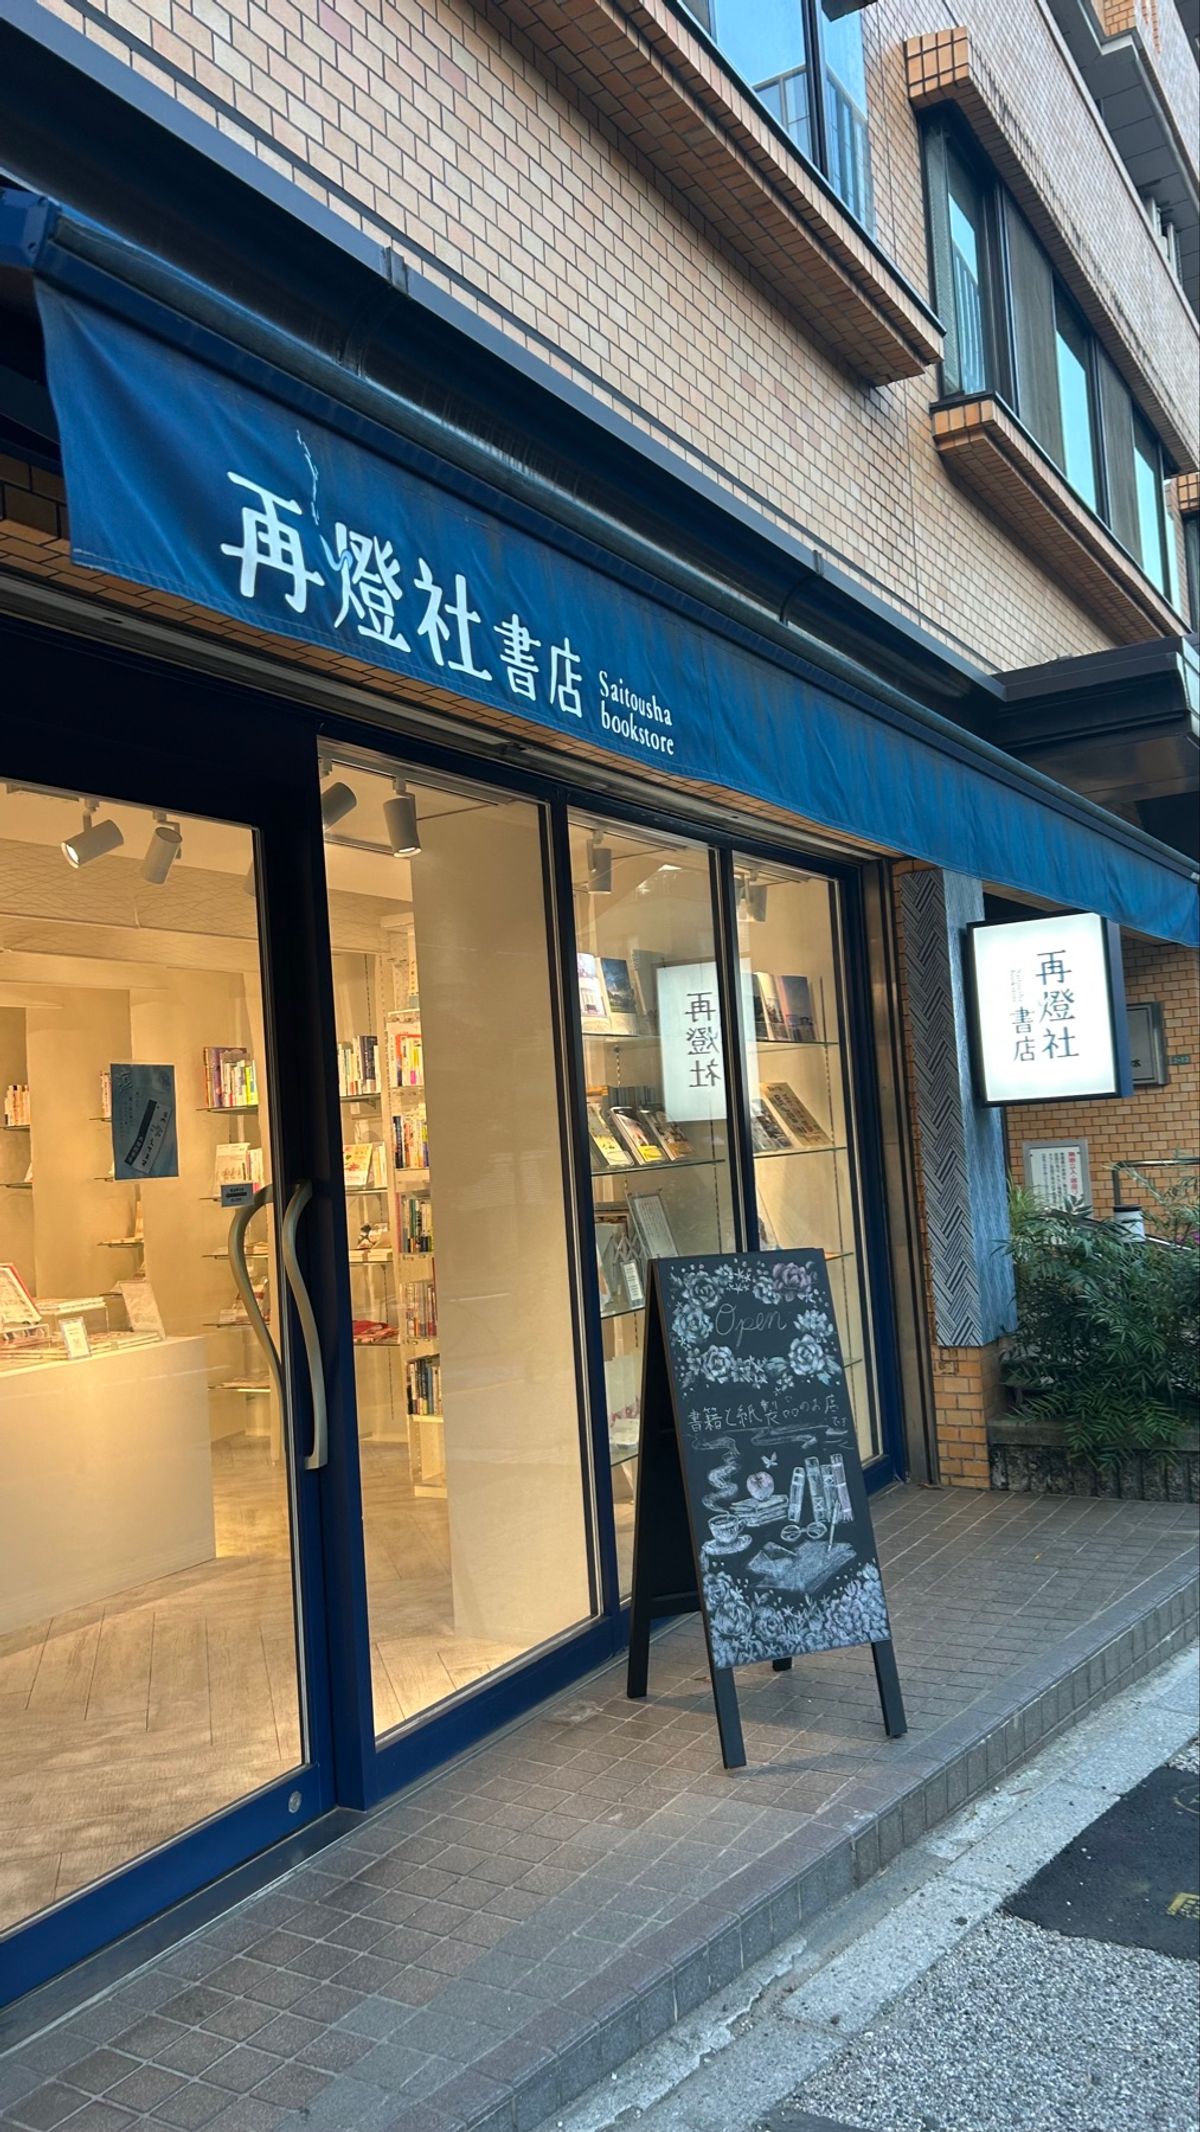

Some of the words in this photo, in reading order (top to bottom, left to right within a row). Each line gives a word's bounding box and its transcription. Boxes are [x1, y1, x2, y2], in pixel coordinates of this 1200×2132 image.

[599, 670, 673, 726] Saitousha
[601, 700, 674, 755] bookstore
[1035, 949, 1080, 1060] 再燈社
[1009, 1006, 1036, 1062] 書店
[715, 1303, 787, 1348] Open
